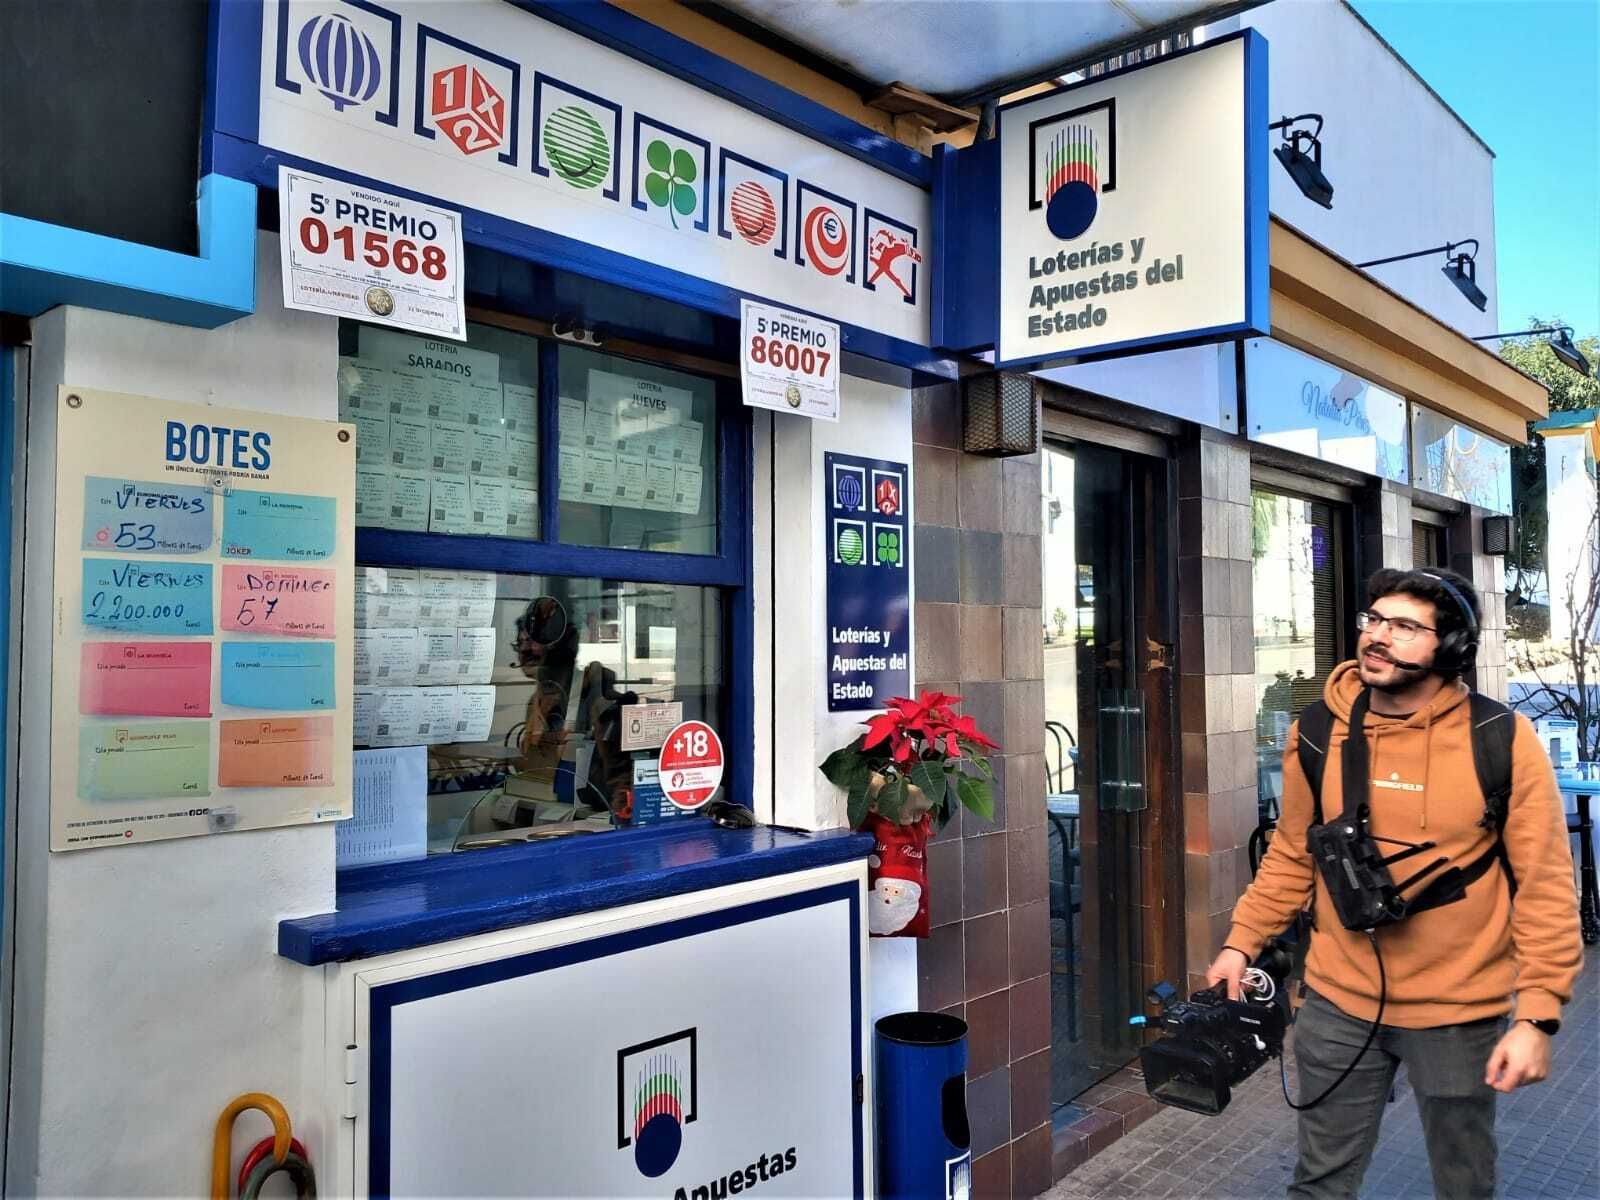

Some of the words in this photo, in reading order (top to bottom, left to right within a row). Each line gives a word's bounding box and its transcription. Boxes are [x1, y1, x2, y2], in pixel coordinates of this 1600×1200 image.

[351, 191, 382, 203] VENDIDO
[335, 199, 437, 241] PREMIO
[300, 216, 447, 281] 01568
[1029, 241, 1124, 280] Loterías
[1130, 237, 1145, 264] y
[1029, 270, 1138, 311] Apuestas
[1145, 254, 1184, 286] del
[771, 321, 827, 348] PREMIO
[1028, 304, 1107, 339] Estado
[751, 335, 831, 378] 86007
[631, 393, 667, 411] JUEVES
[166, 420, 271, 471] BOTES
[114, 523, 156, 550] 53
[226, 547, 252, 555] JOKER
[832, 626, 881, 644] Loterías
[883, 631, 891, 648] y
[832, 654, 887, 676] Apuestas
[889, 652, 907, 670] del
[832, 680, 873, 699] Estado
[673, 730, 708, 757] +18
